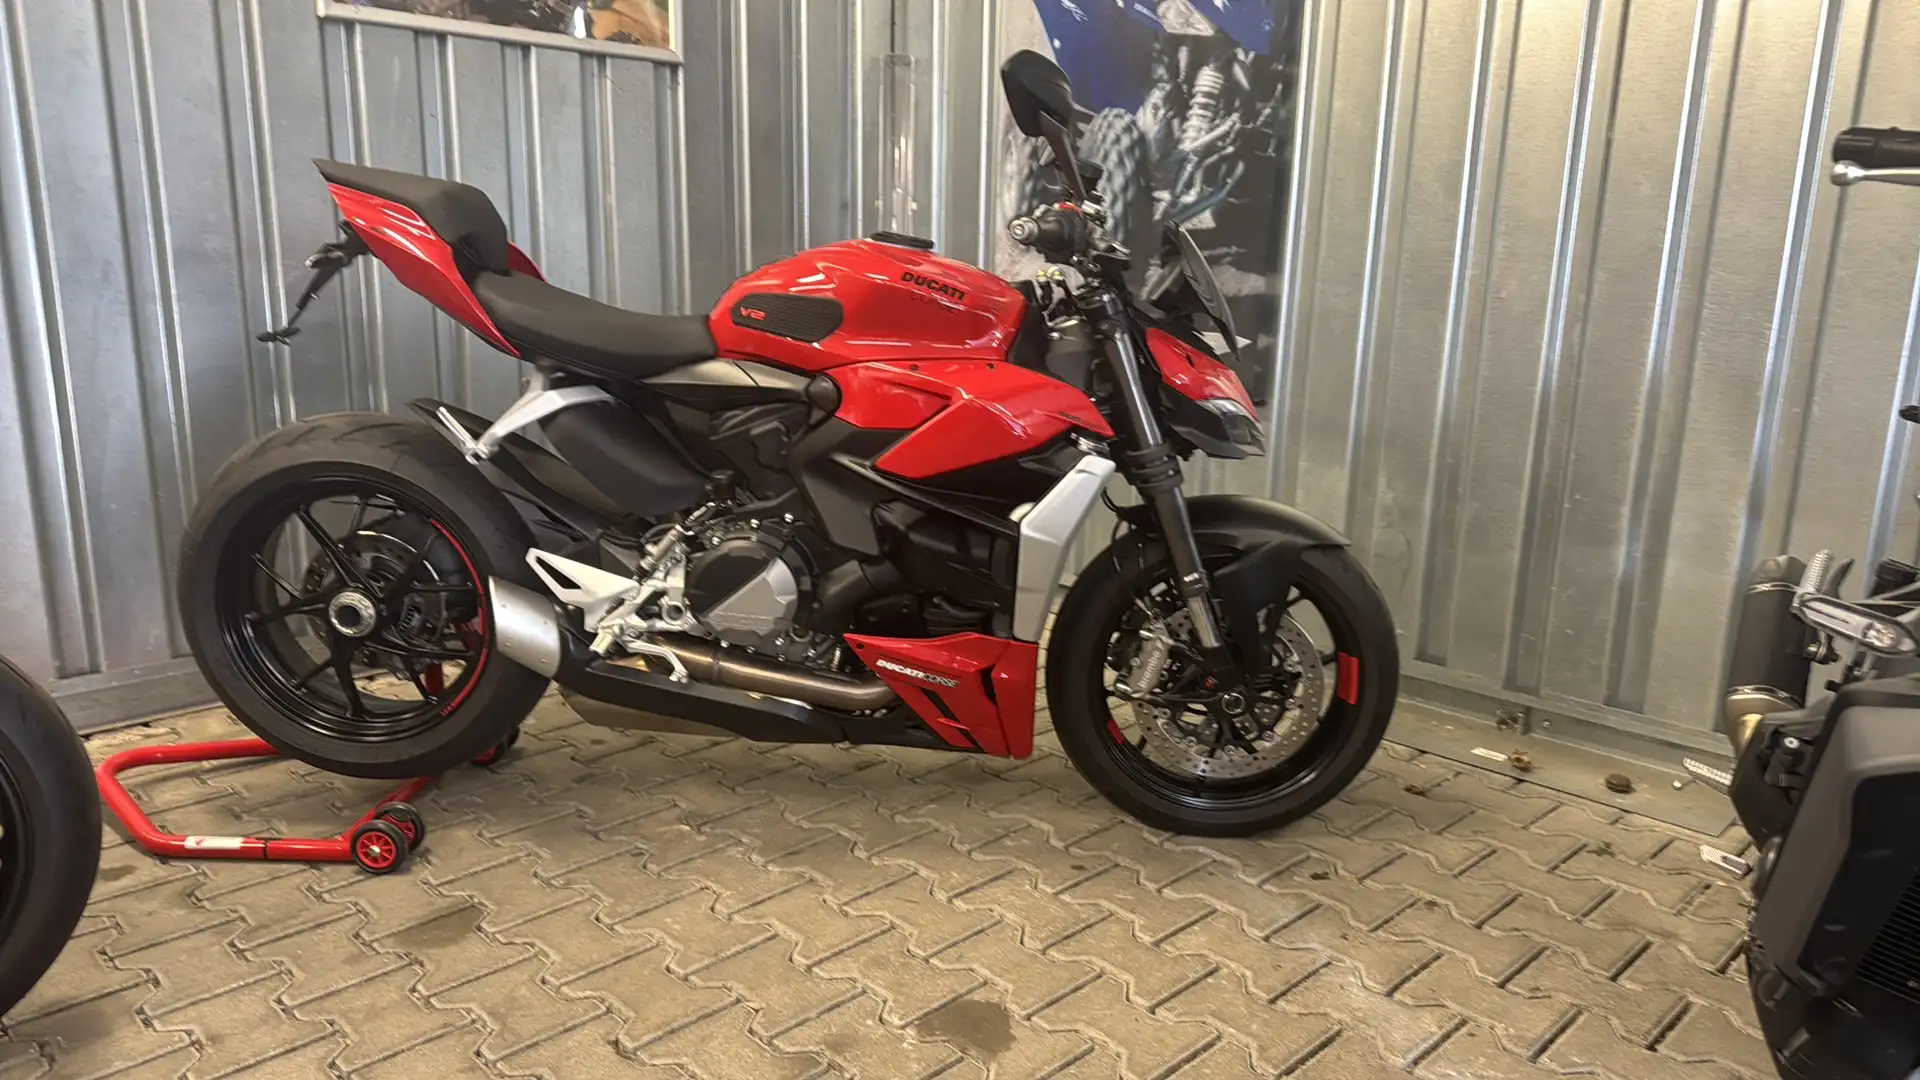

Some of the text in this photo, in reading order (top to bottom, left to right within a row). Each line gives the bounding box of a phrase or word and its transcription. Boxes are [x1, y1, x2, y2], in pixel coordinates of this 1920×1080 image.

[901, 271, 966, 301] DUCATI
[740, 306, 767, 321] V2
[1136, 650, 1161, 689] brembo
